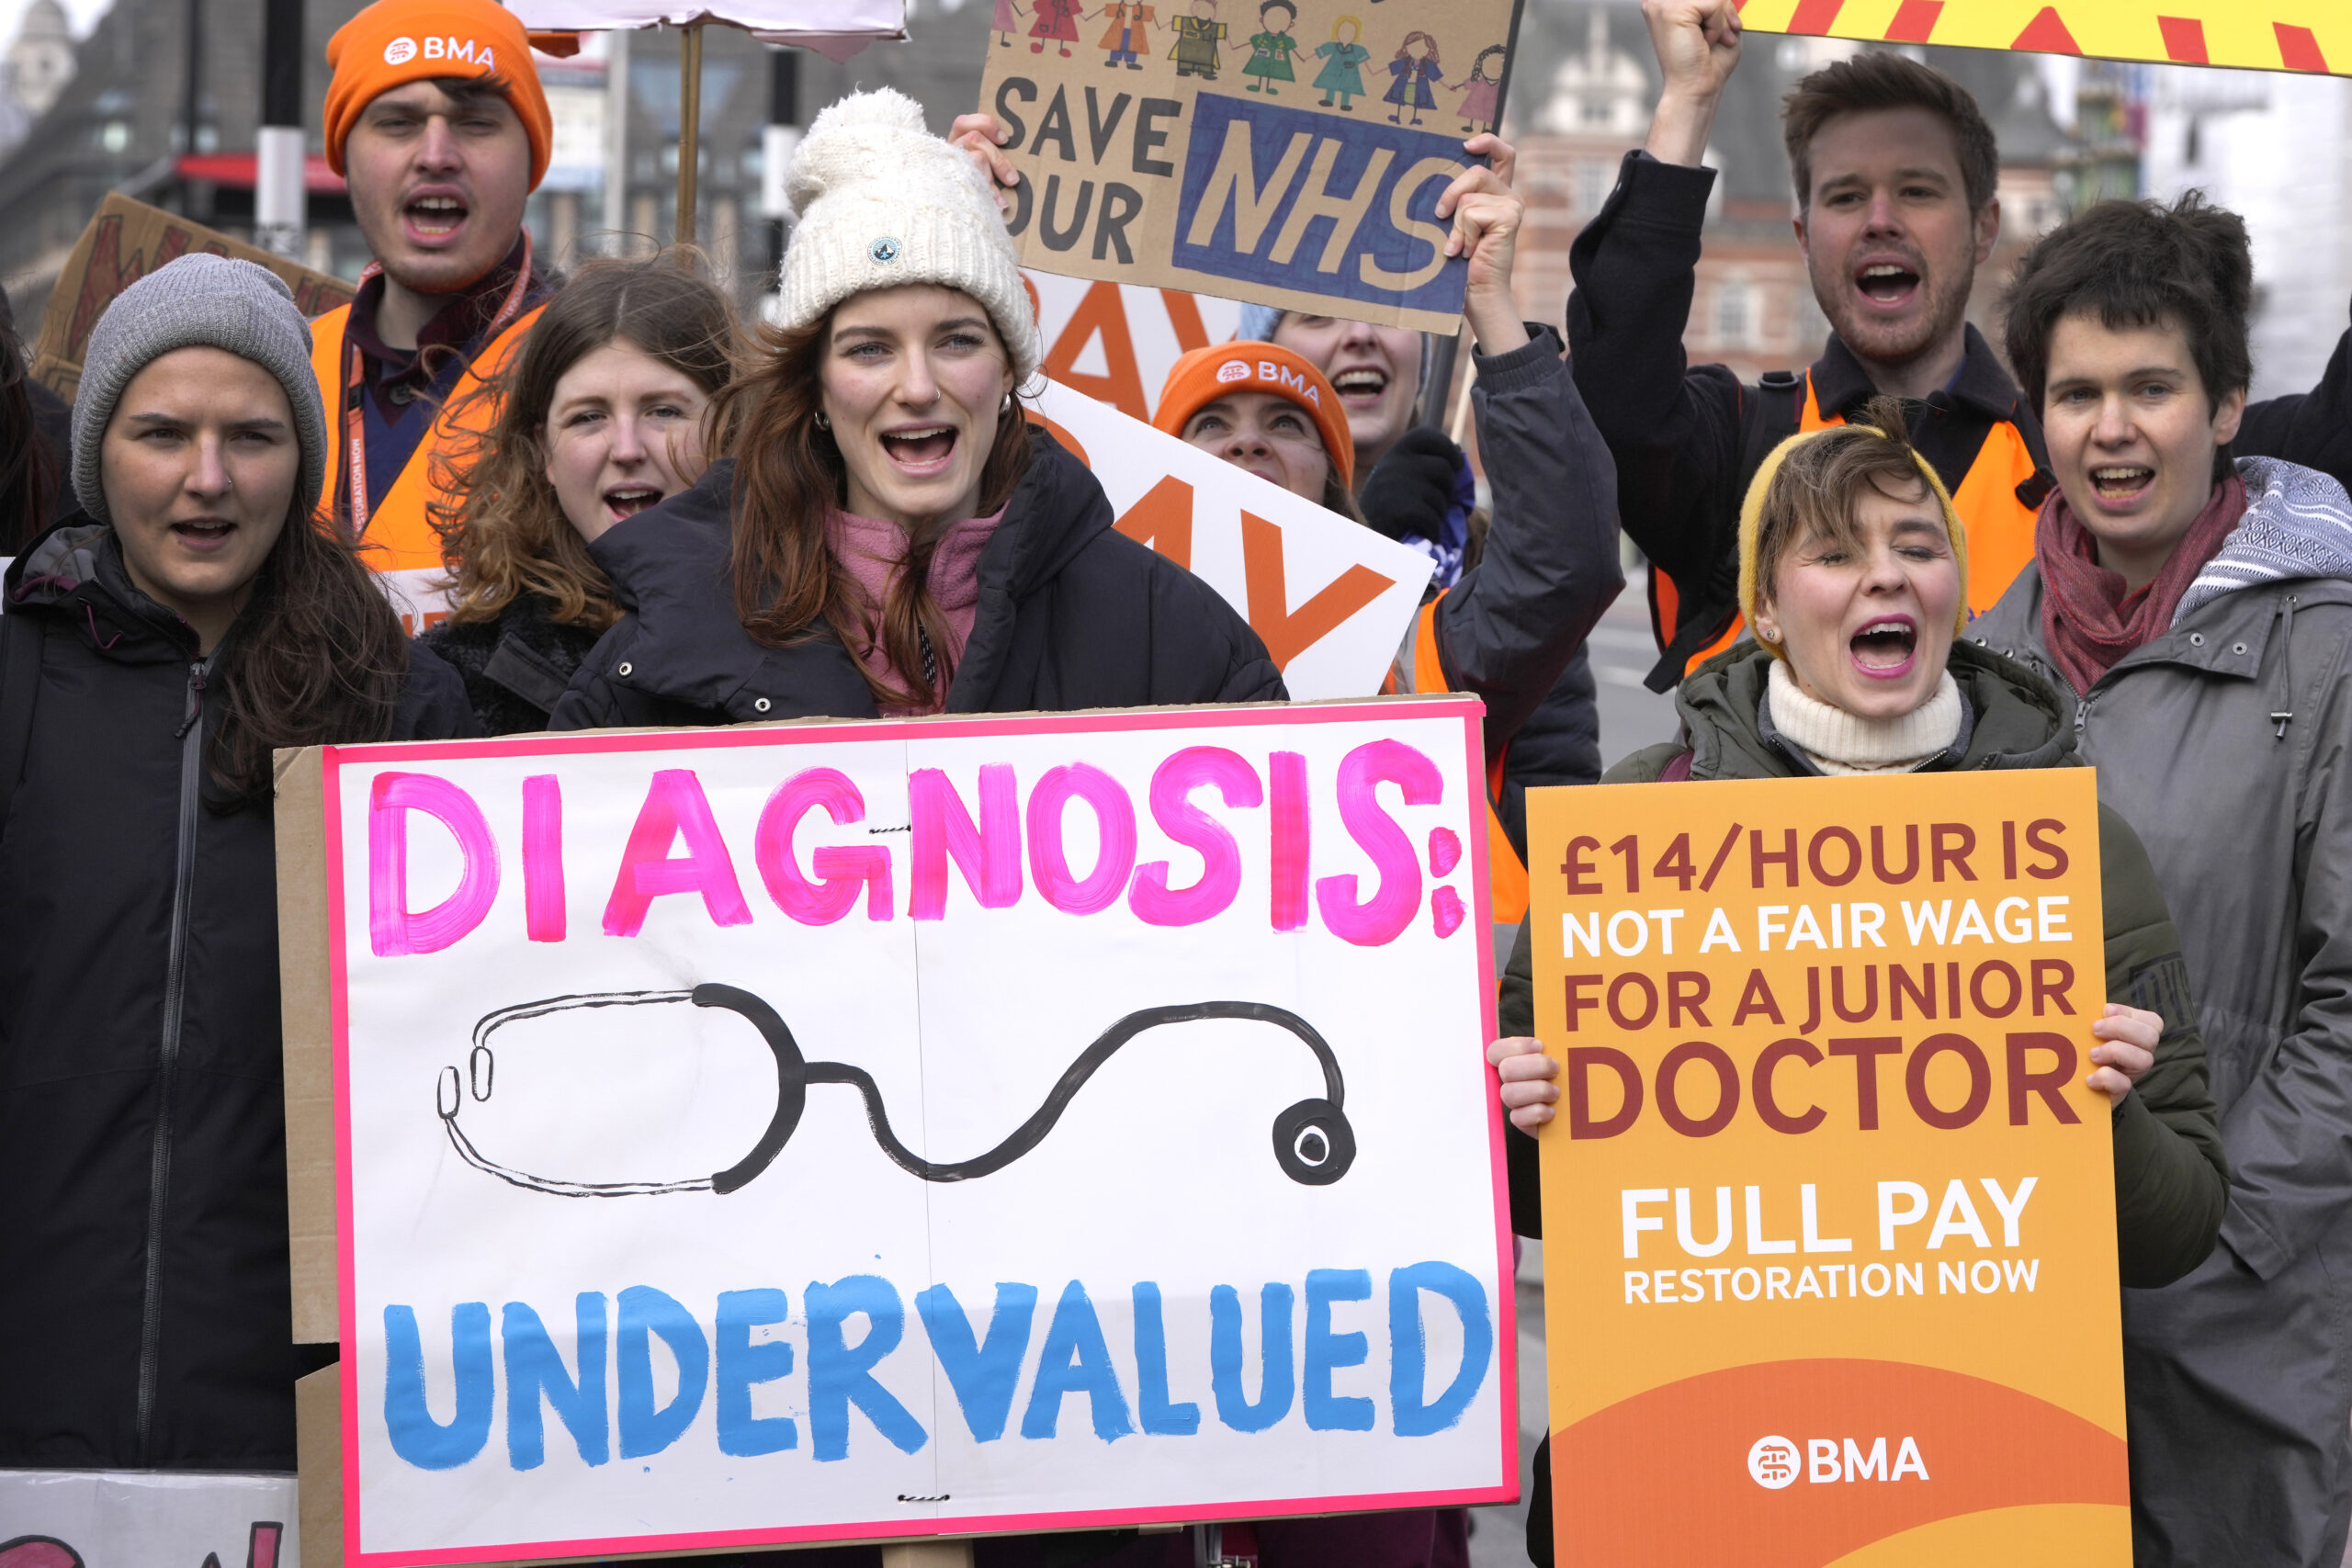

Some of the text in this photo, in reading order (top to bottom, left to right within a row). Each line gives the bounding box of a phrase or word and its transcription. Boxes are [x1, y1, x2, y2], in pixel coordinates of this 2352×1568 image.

[424, 36, 495, 73] BMA
[995, 76, 1183, 178] SAVE
[1186, 118, 1463, 291] NHS
[1258, 360, 1320, 409] BMA
[352, 438, 362, 464] NOW
[368, 739, 1464, 957] DIAGNOSIS:
[1561, 818, 2070, 896] £14/HOUR IS
[1563, 896, 2073, 958] NOT A FAIR WAGE
[1565, 971, 1713, 1032] FOR
[1732, 968, 1786, 1027] A
[1799, 958, 2077, 1036] JUNIOR
[1567, 1031, 2084, 1141] DOCTOR
[1621, 1177, 2039, 1258] FULL PAY
[1624, 1258, 2040, 1304] RESTORATION NOW
[383, 1259, 1494, 1472] UNDERVALUED
[1807, 1436, 1930, 1483] BMA
